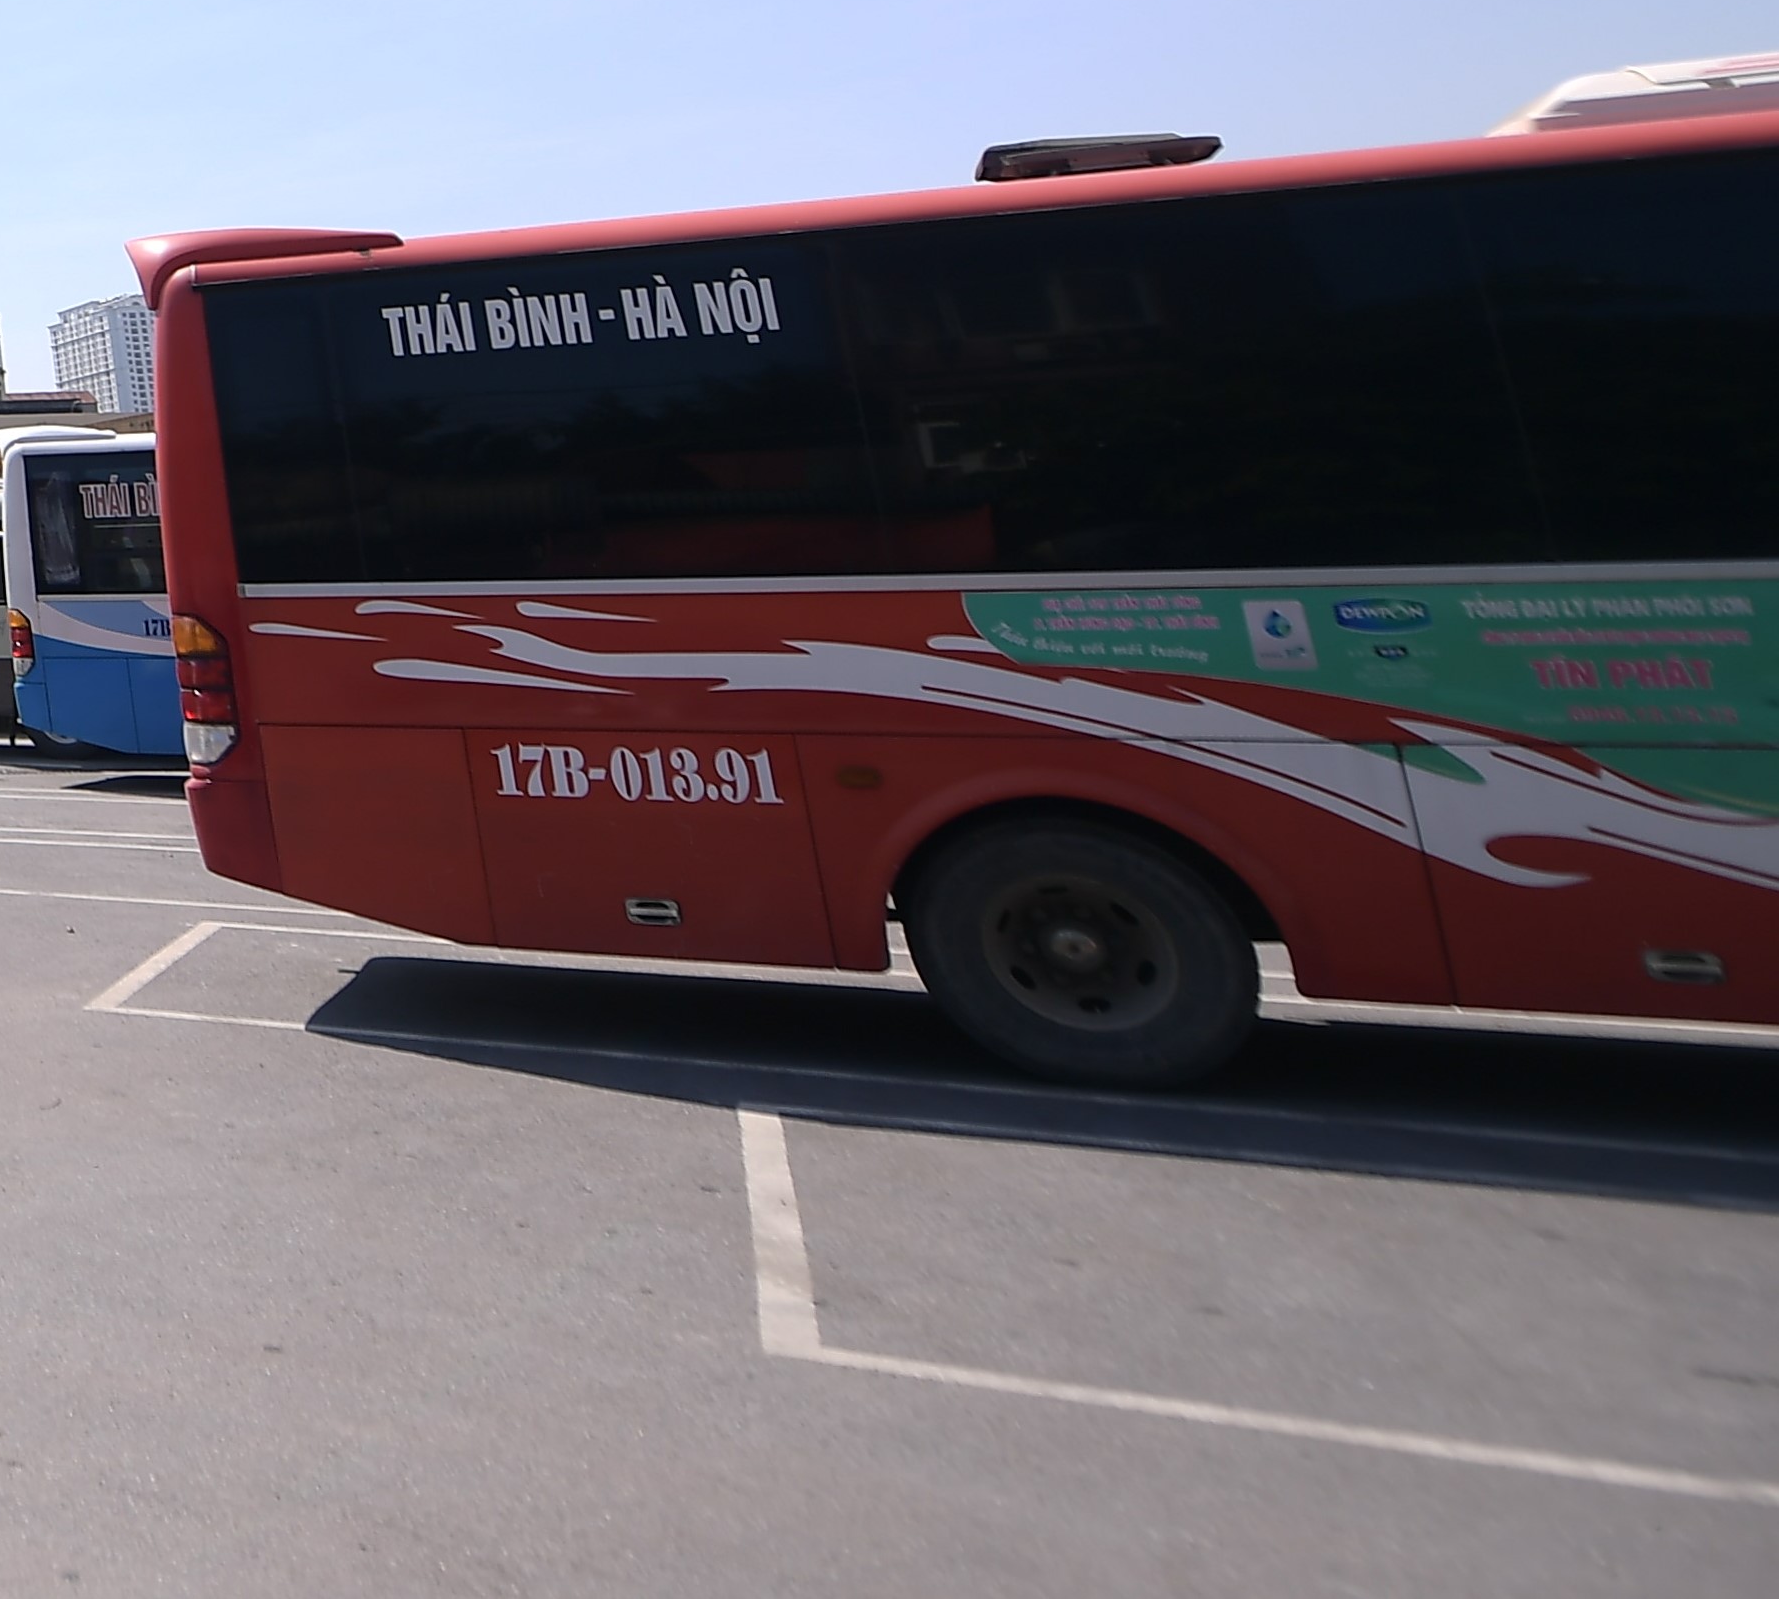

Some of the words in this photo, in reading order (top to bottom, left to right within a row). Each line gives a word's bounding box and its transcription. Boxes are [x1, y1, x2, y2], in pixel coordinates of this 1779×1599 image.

[382, 293, 476, 356] THÁI
[484, 287, 593, 350] BÌNH
[619, 274, 687, 340] HÀ
[693, 268, 781, 344] NỘI
[79, 474, 131, 518] THÁI
[490, 742, 784, 804] 17B-013.91
